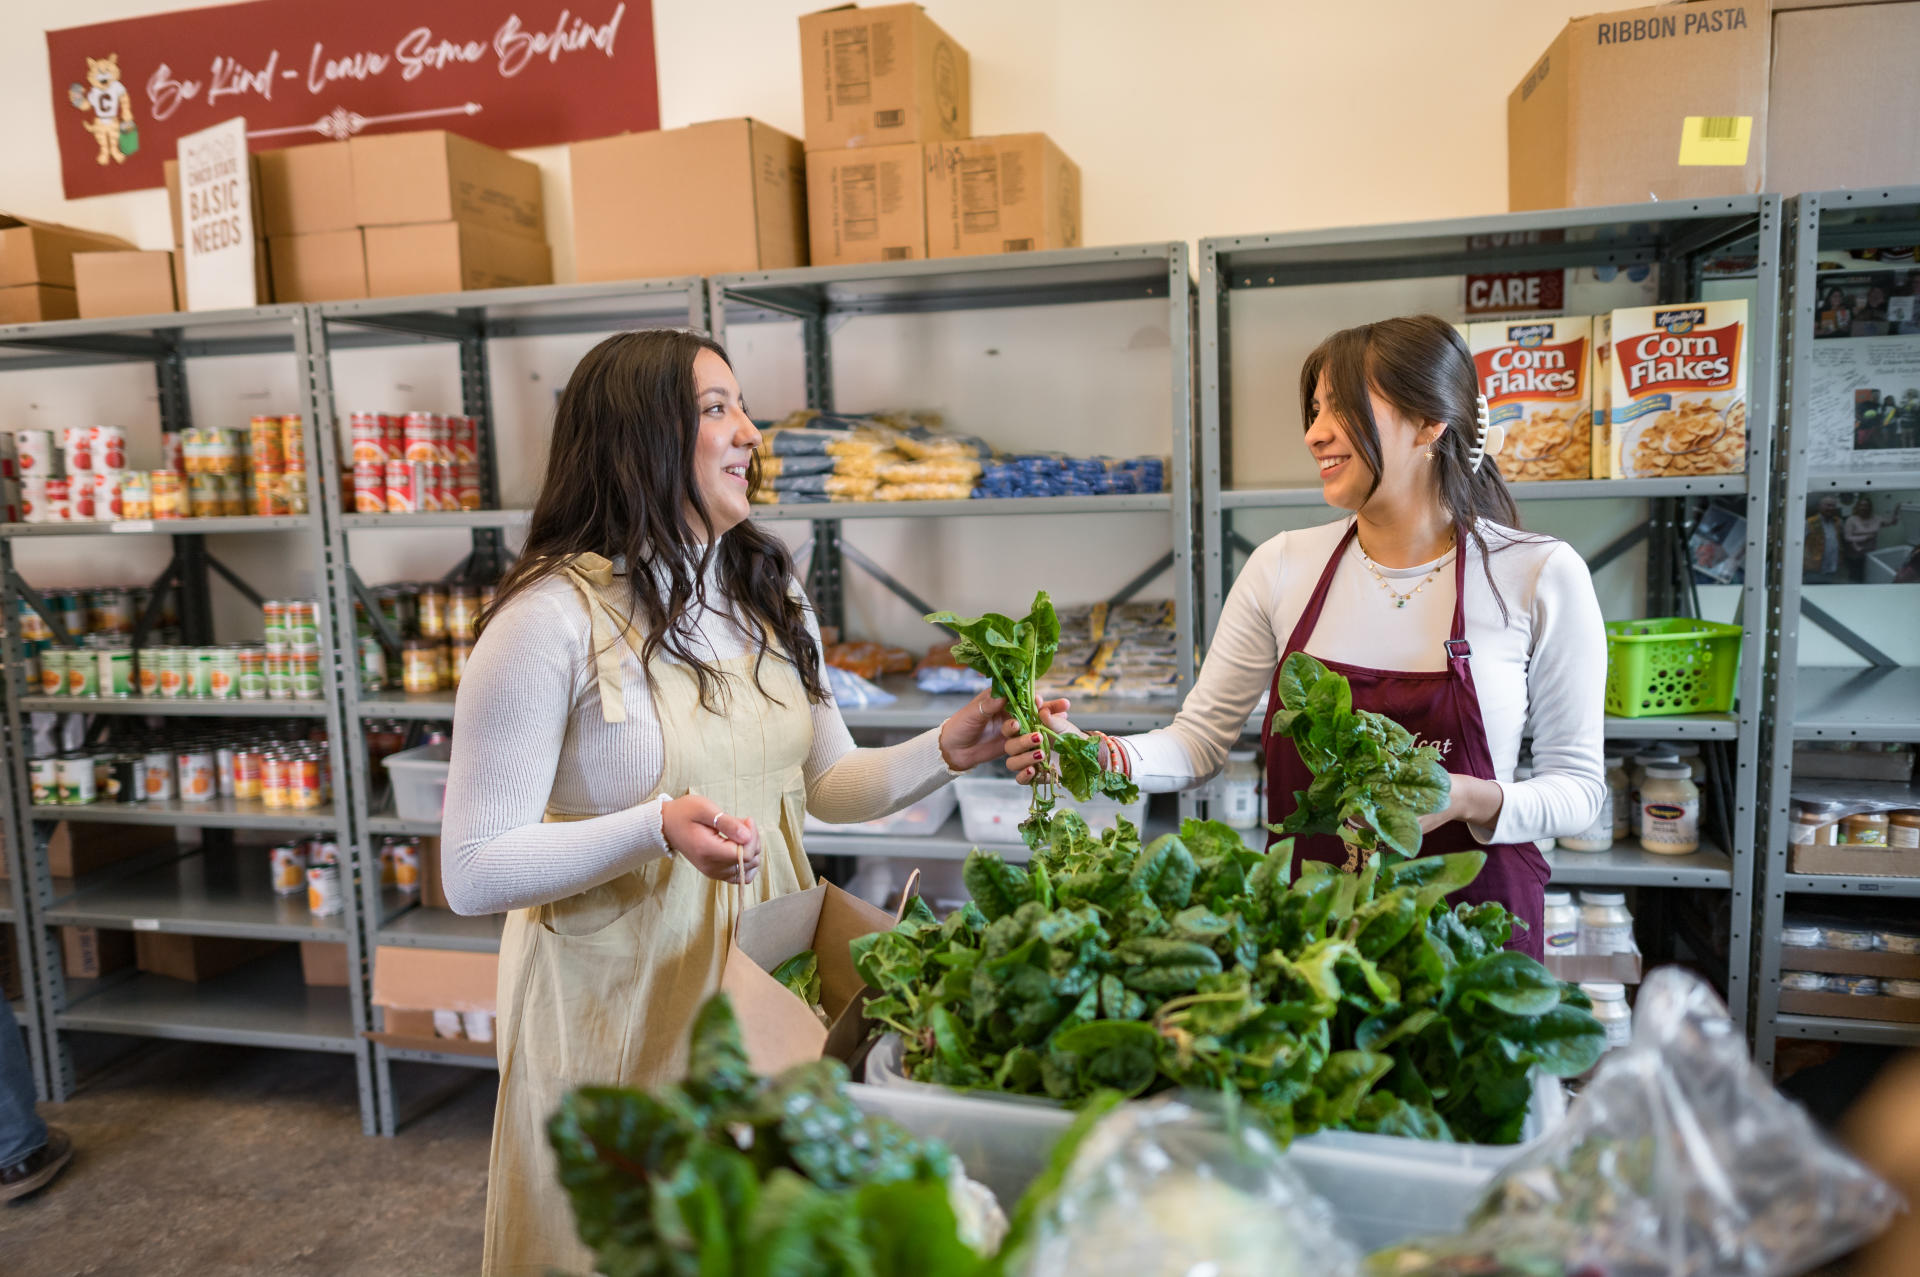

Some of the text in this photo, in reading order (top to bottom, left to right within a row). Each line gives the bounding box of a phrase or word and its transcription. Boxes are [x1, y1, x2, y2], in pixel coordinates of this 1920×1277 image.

[1597, 7, 1748, 45] RIBBON PASTA
[146, 63, 201, 120] Be
[208, 49, 278, 106] Kind
[307, 42, 389, 94] Leave
[395, 27, 487, 81] Some
[493, 2, 625, 78] Behind
[190, 179, 239, 221] BASIC
[192, 215, 242, 256] NEEDS
[1491, 348, 1566, 372] Corn
[1636, 334, 1719, 361] Corn
[1485, 368, 1576, 399] Flakes
[1629, 356, 1730, 390] Flakes
